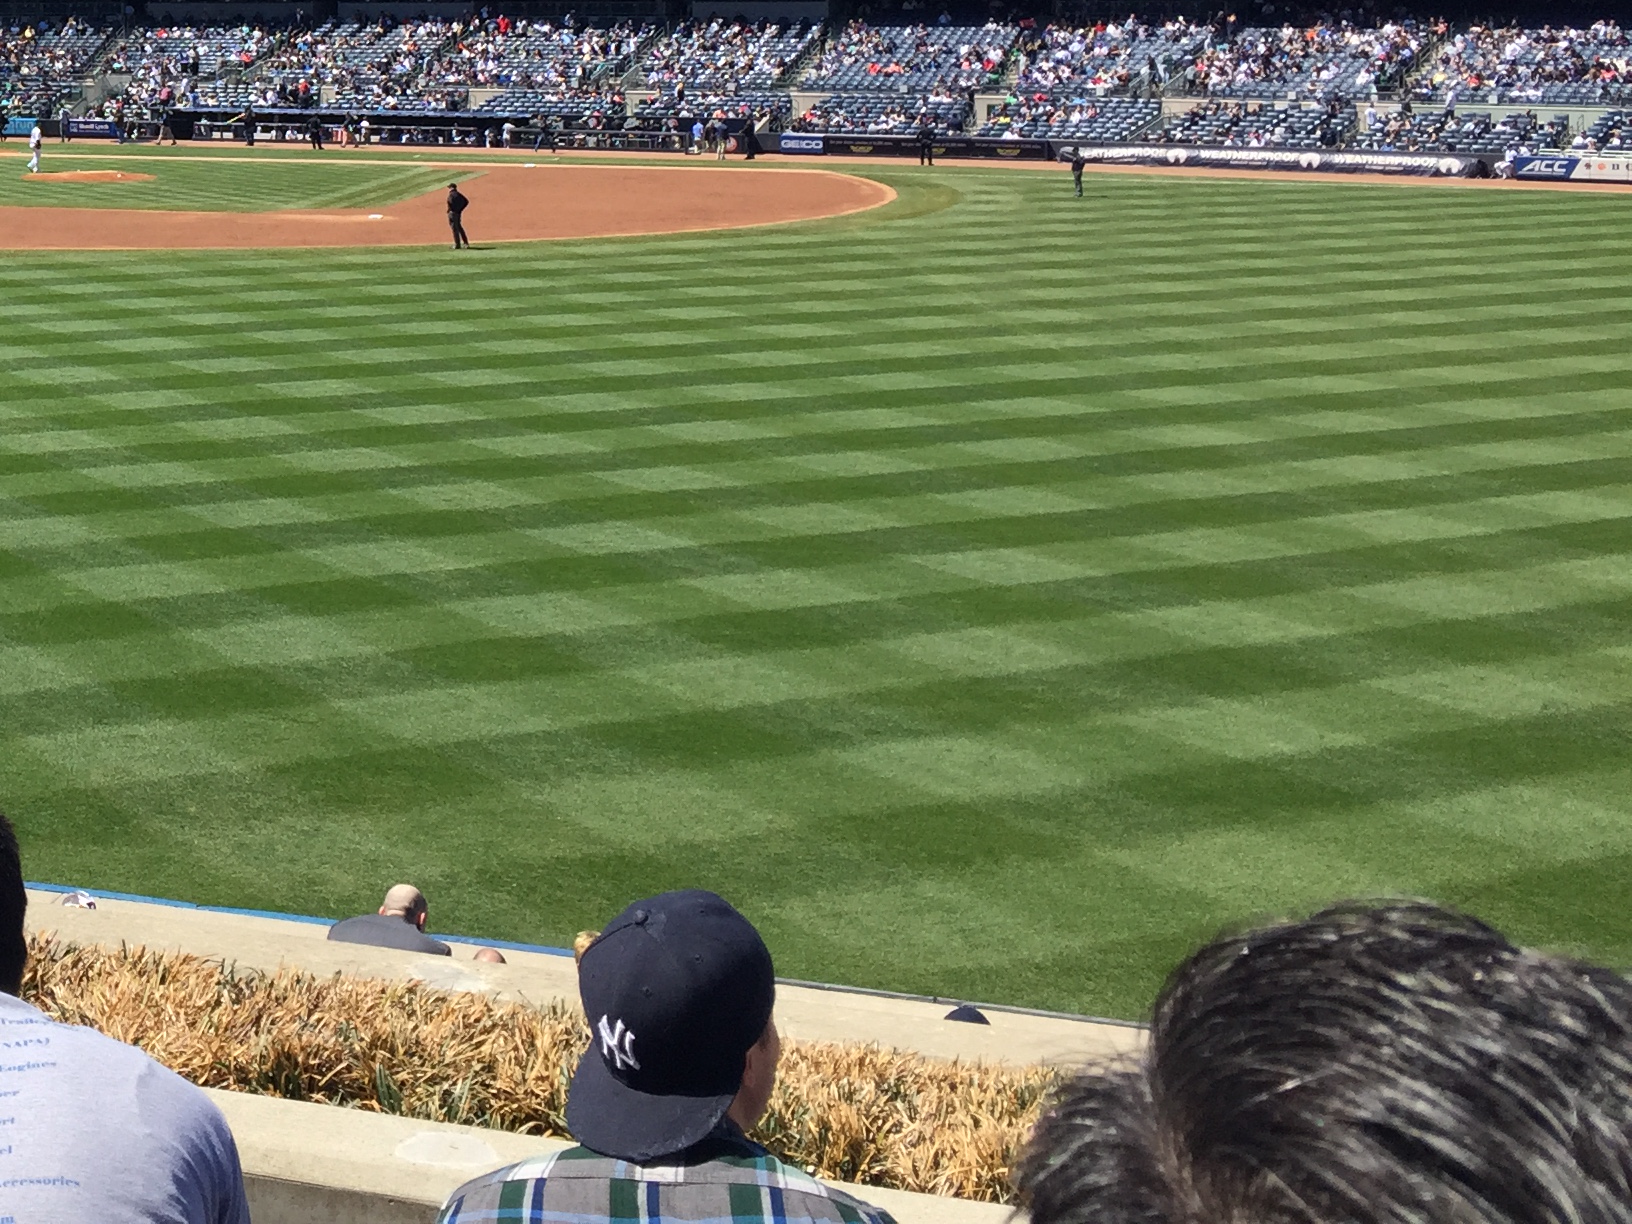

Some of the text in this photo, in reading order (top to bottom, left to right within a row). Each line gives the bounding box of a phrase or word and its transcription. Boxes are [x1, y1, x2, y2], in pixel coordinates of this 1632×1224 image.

[781, 139, 824, 149] GEICO
[1082, 147, 1169, 160] EATHERPROOF
[1200, 150, 1304, 162] WEATHERPROOF
[1333, 154, 1438, 167] WEATHERPROOF
[1526, 160, 1569, 173] ACC
